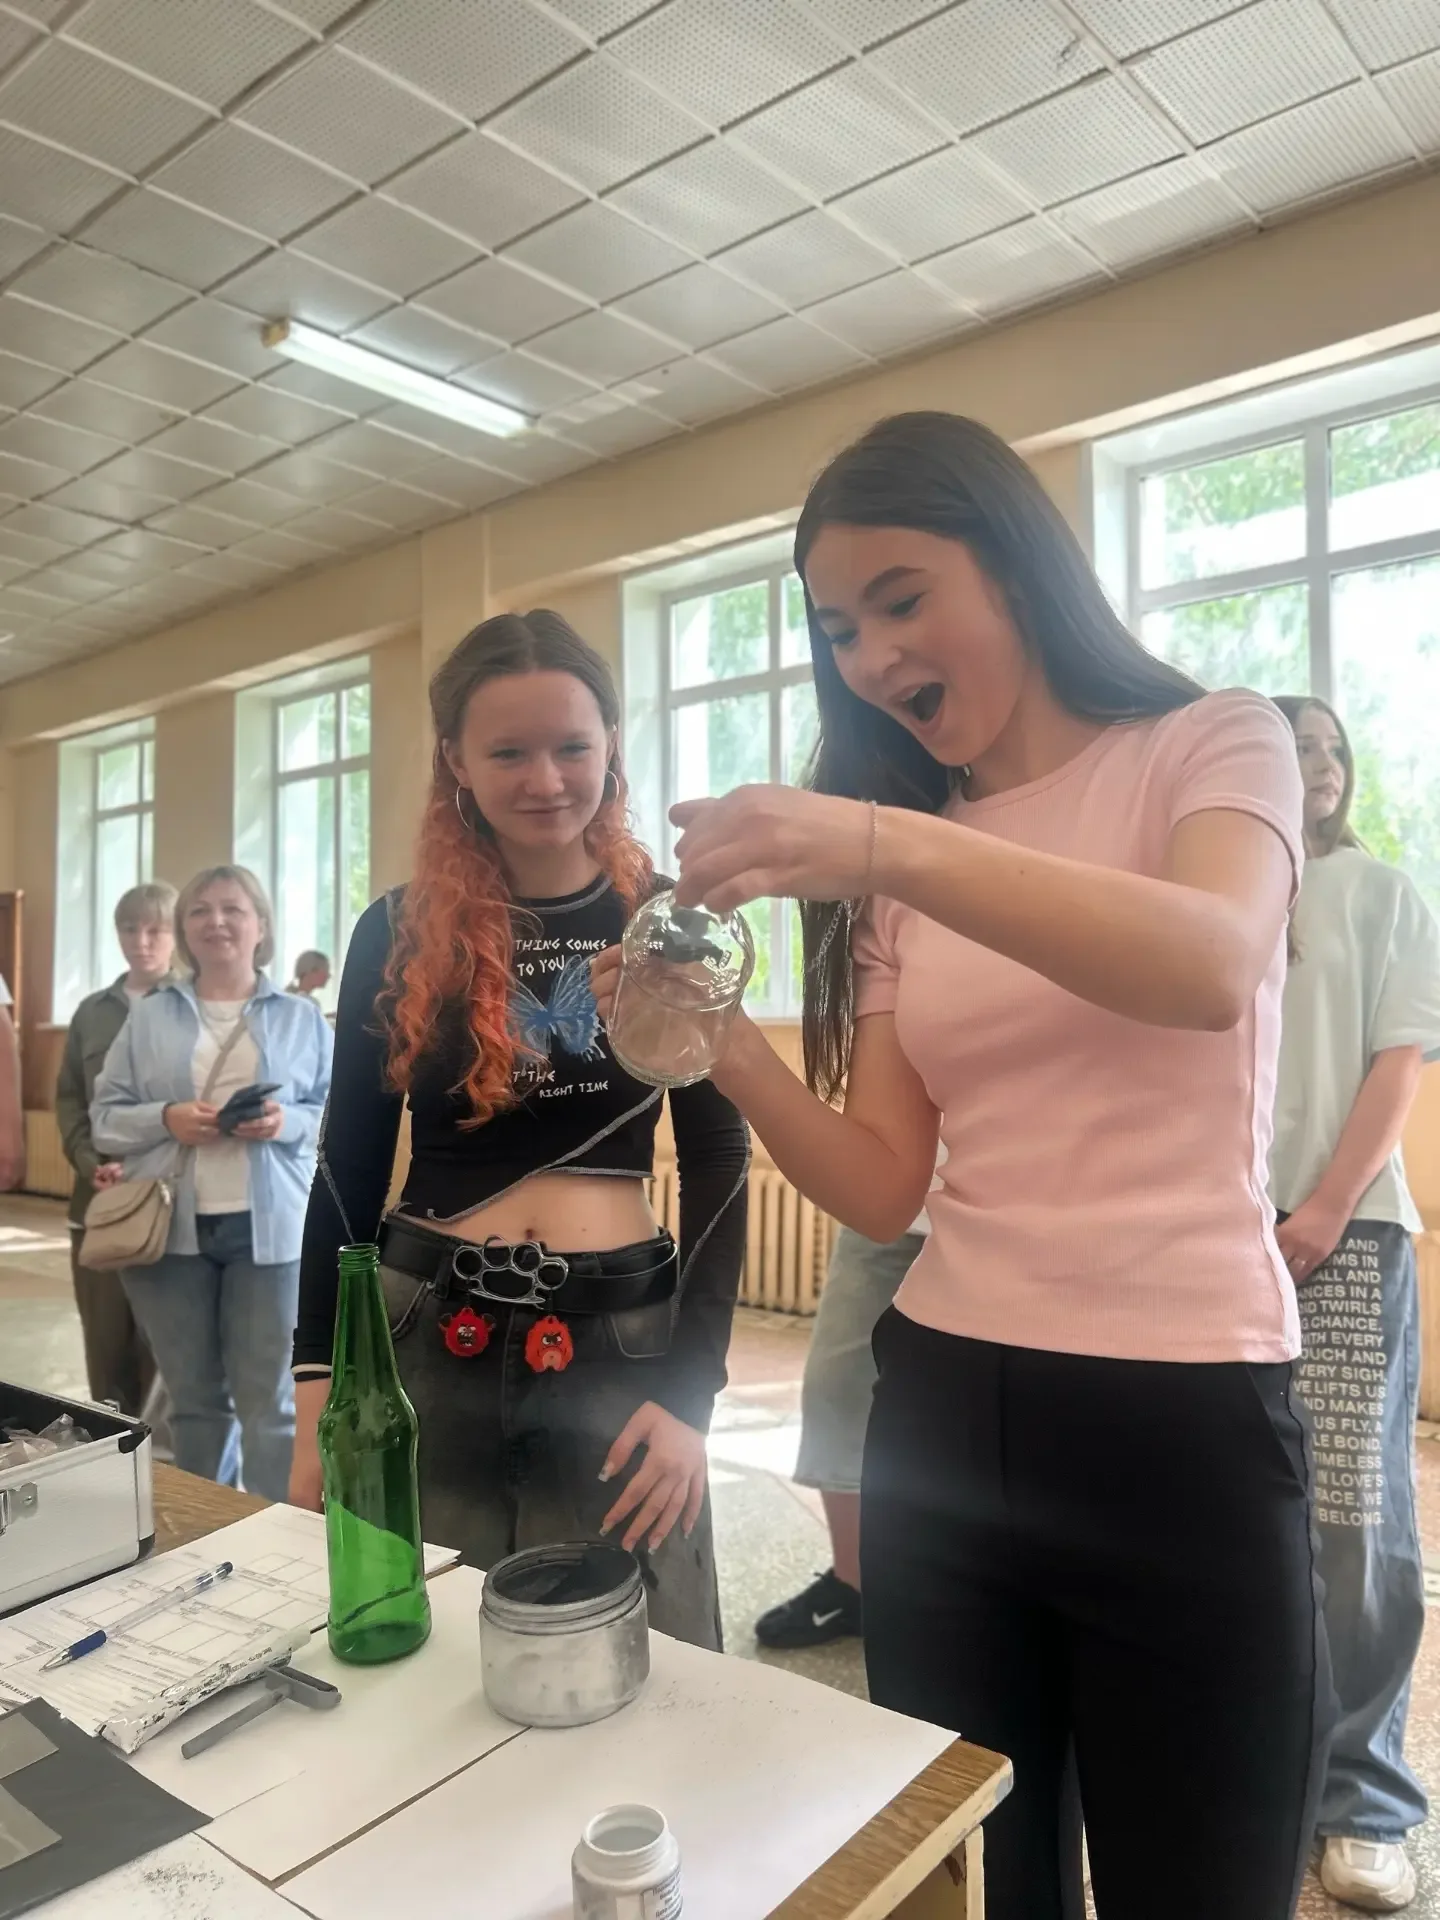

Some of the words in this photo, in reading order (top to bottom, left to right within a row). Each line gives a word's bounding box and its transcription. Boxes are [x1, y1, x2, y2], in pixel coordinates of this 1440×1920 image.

[566, 938, 607, 950] COMES
[517, 963, 534, 976] TO
[539, 955, 564, 973] YOU
[528, 1070, 555, 1082] THE
[540, 1085, 573, 1098] RIGHT
[580, 1081, 608, 1092] TIME
[1346, 1238, 1379, 1253] AND
[1362, 1256, 1379, 1268] IN
[1313, 1268, 1342, 1282] ALL
[1345, 1270, 1381, 1283] AND
[1298, 1285, 1346, 1298] ANCES
[1350, 1286, 1367, 1299] IN
[1371, 1288, 1382, 1300] A
[1299, 1302, 1317, 1314] ND
[1320, 1300, 1381, 1316] TWIRLS
[1311, 1316, 1382, 1331] CHANCE.
[1331, 1332, 1384, 1348] EVERY
[1301, 1348, 1347, 1361] OUCH
[1352, 1350, 1387, 1365] AND
[1299, 1364, 1337, 1377] VERY
[1293, 1380, 1311, 1394] VE
[1314, 1381, 1361, 1397] LIFTS
[1365, 1385, 1386, 1399] US
[1304, 1397, 1326, 1411] ND
[1329, 1399, 1384, 1416] MAKES
[1313, 1416, 1336, 1430] US
[1375, 1420, 1383, 1433] A
[1312, 1433, 1330, 1447] LE
[1312, 1452, 1382, 1469] TIMELESS
[1363, 1492, 1383, 1506] WE
